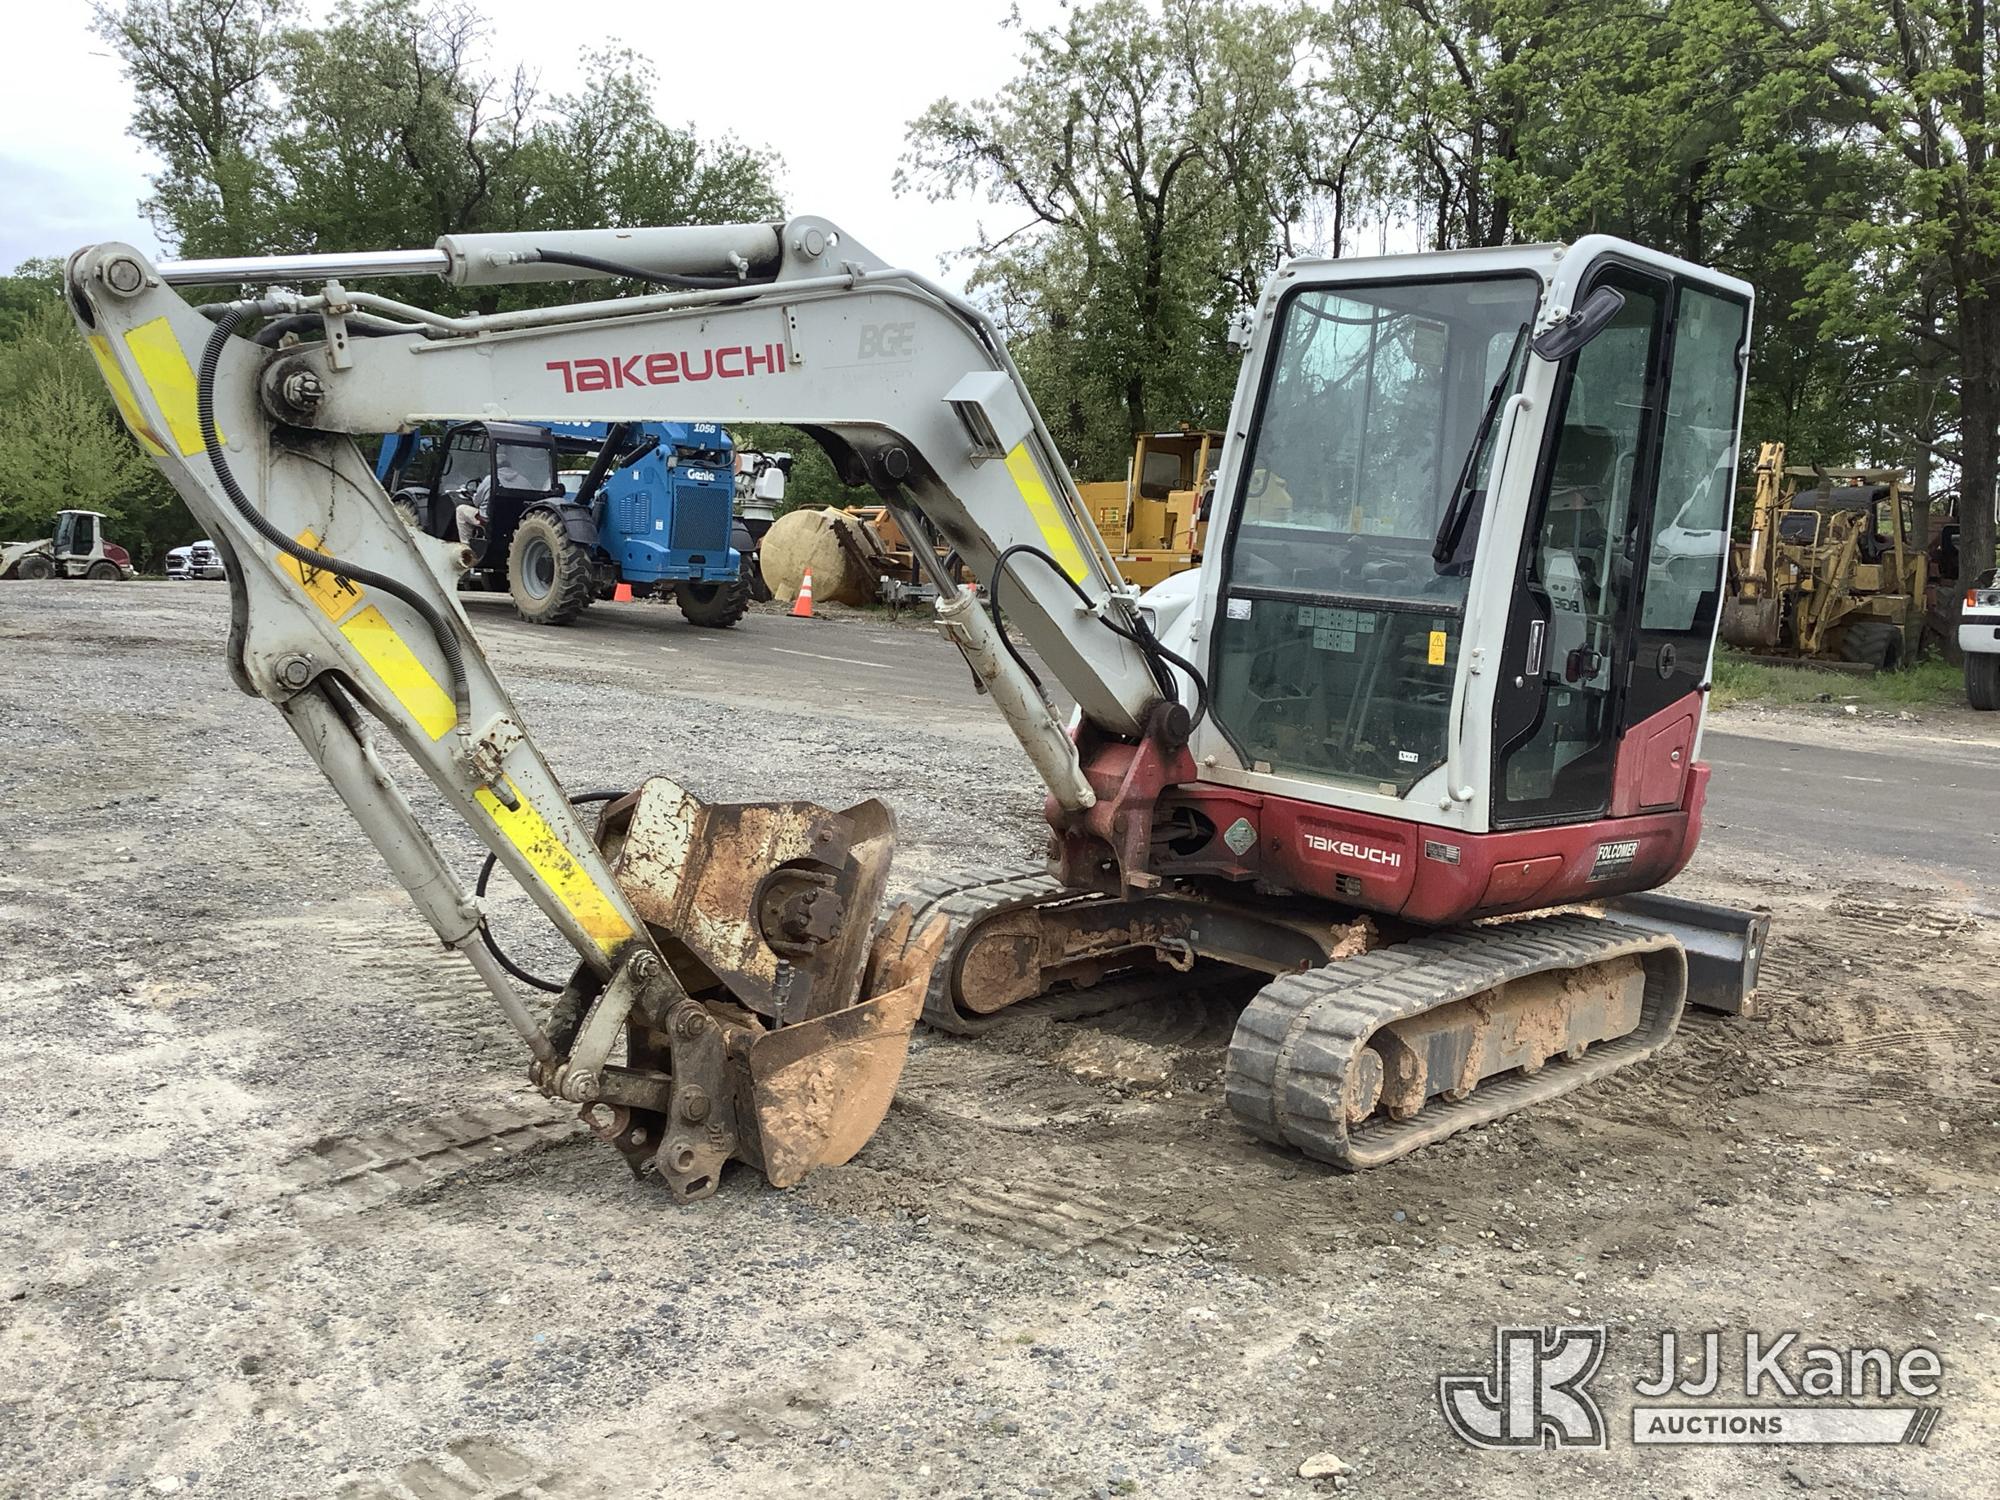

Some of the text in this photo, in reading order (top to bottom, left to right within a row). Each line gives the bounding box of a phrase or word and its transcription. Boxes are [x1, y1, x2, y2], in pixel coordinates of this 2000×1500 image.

[857, 320, 916, 360] BGE
[693, 422, 717, 435] 1056
[687, 468, 716, 482] Genie
[1597, 842, 1638, 861] FOLCOMER
